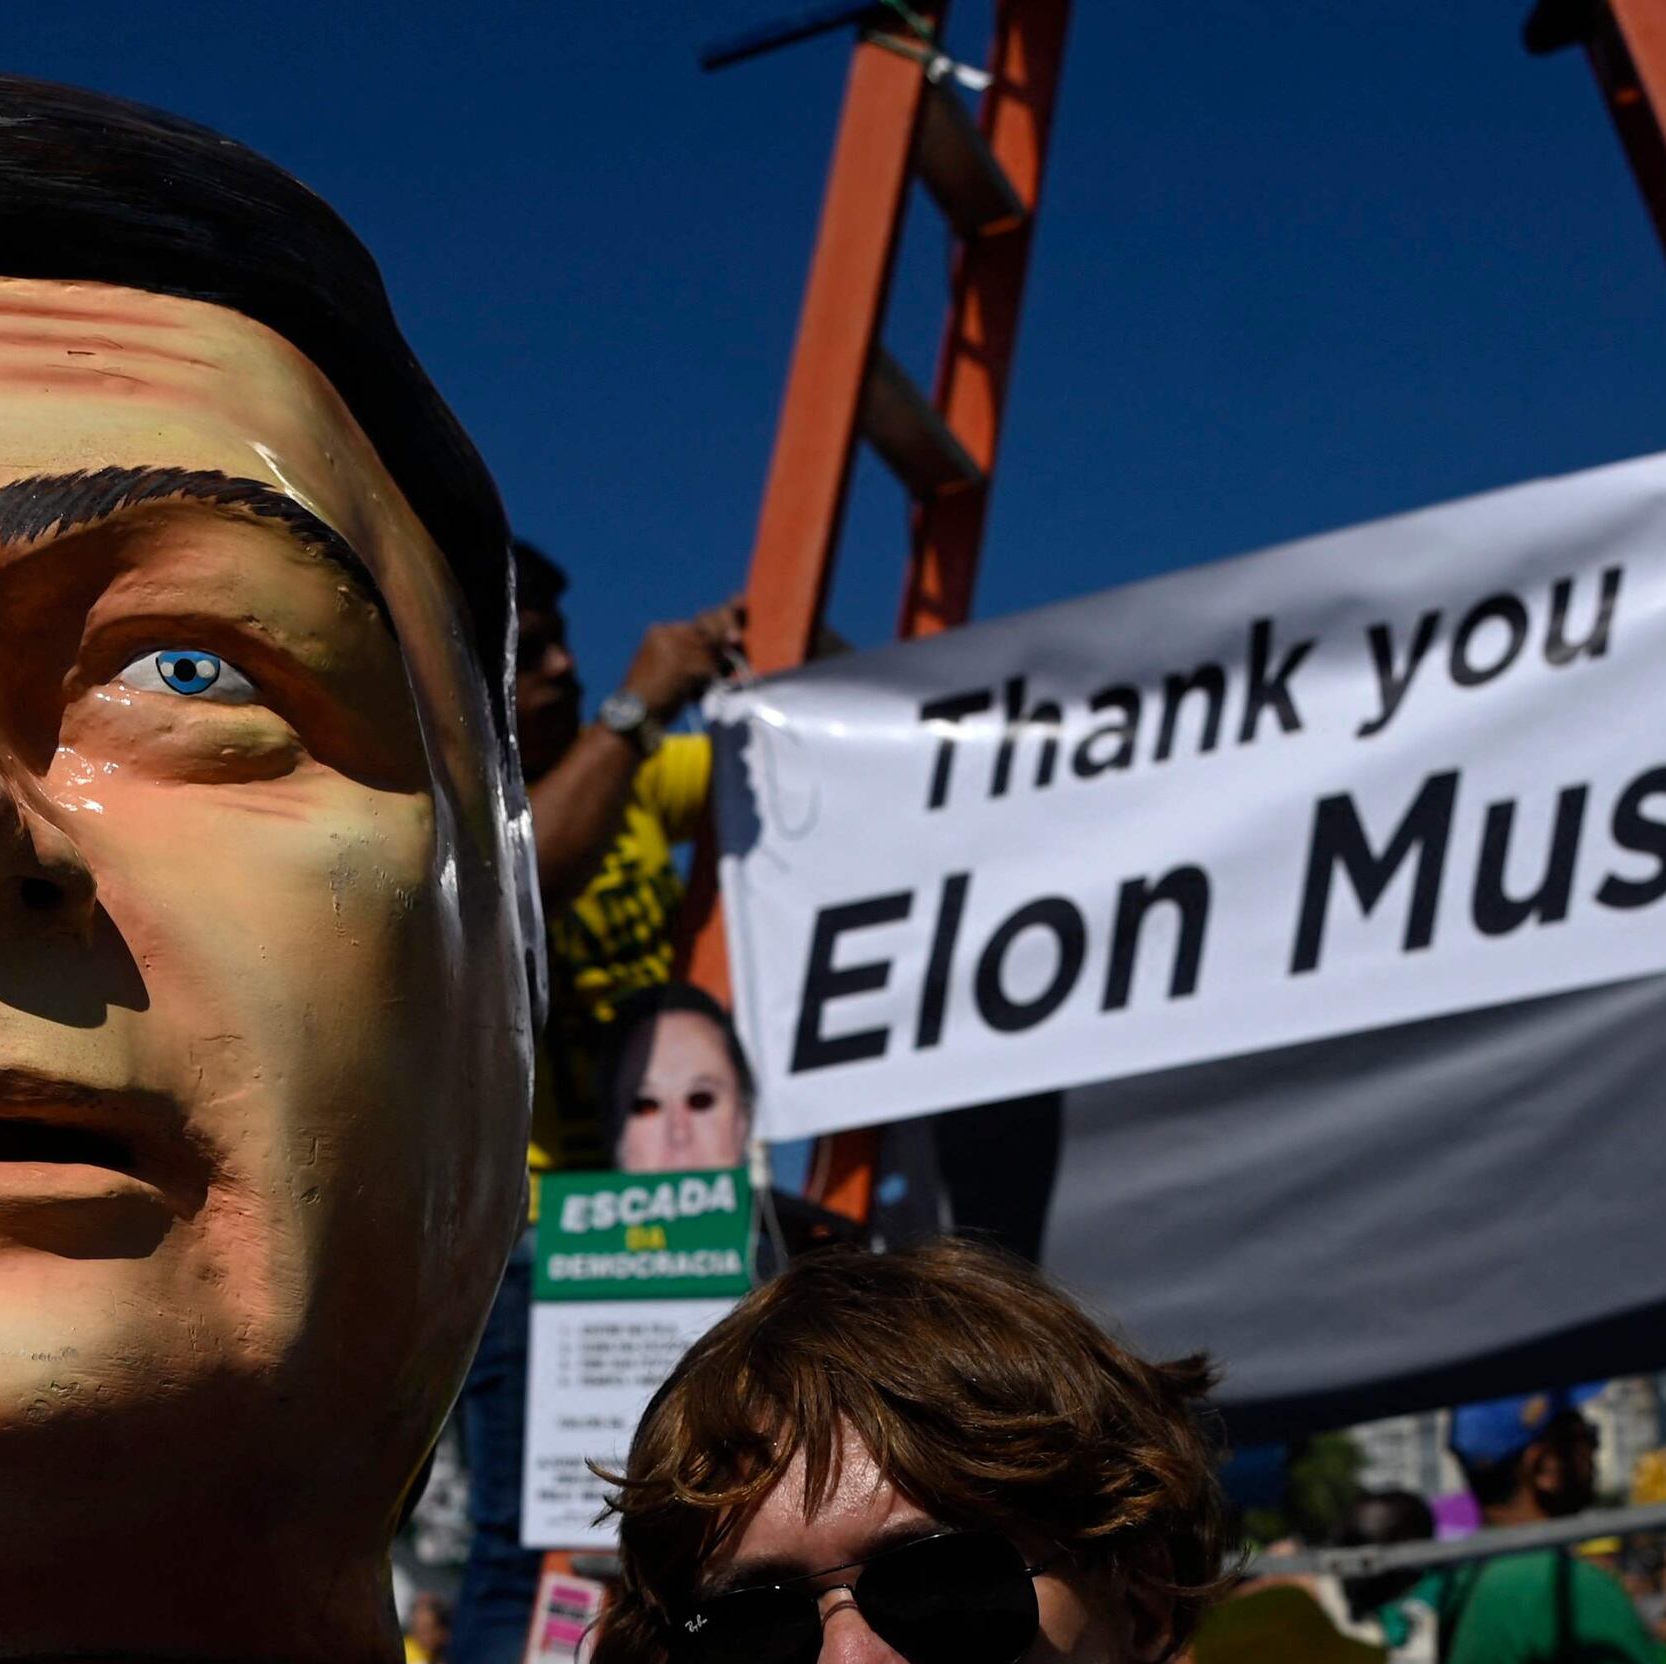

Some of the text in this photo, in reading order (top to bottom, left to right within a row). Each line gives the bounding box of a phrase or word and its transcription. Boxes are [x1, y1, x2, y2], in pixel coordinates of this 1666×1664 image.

[919, 565, 1628, 811] Thank you
[788, 862, 1213, 1075] Elon
[560, 1173, 737, 1233] ESCADA
[547, 1250, 741, 1280] DEMOCRACIA
[625, 1225, 667, 1252] DA
